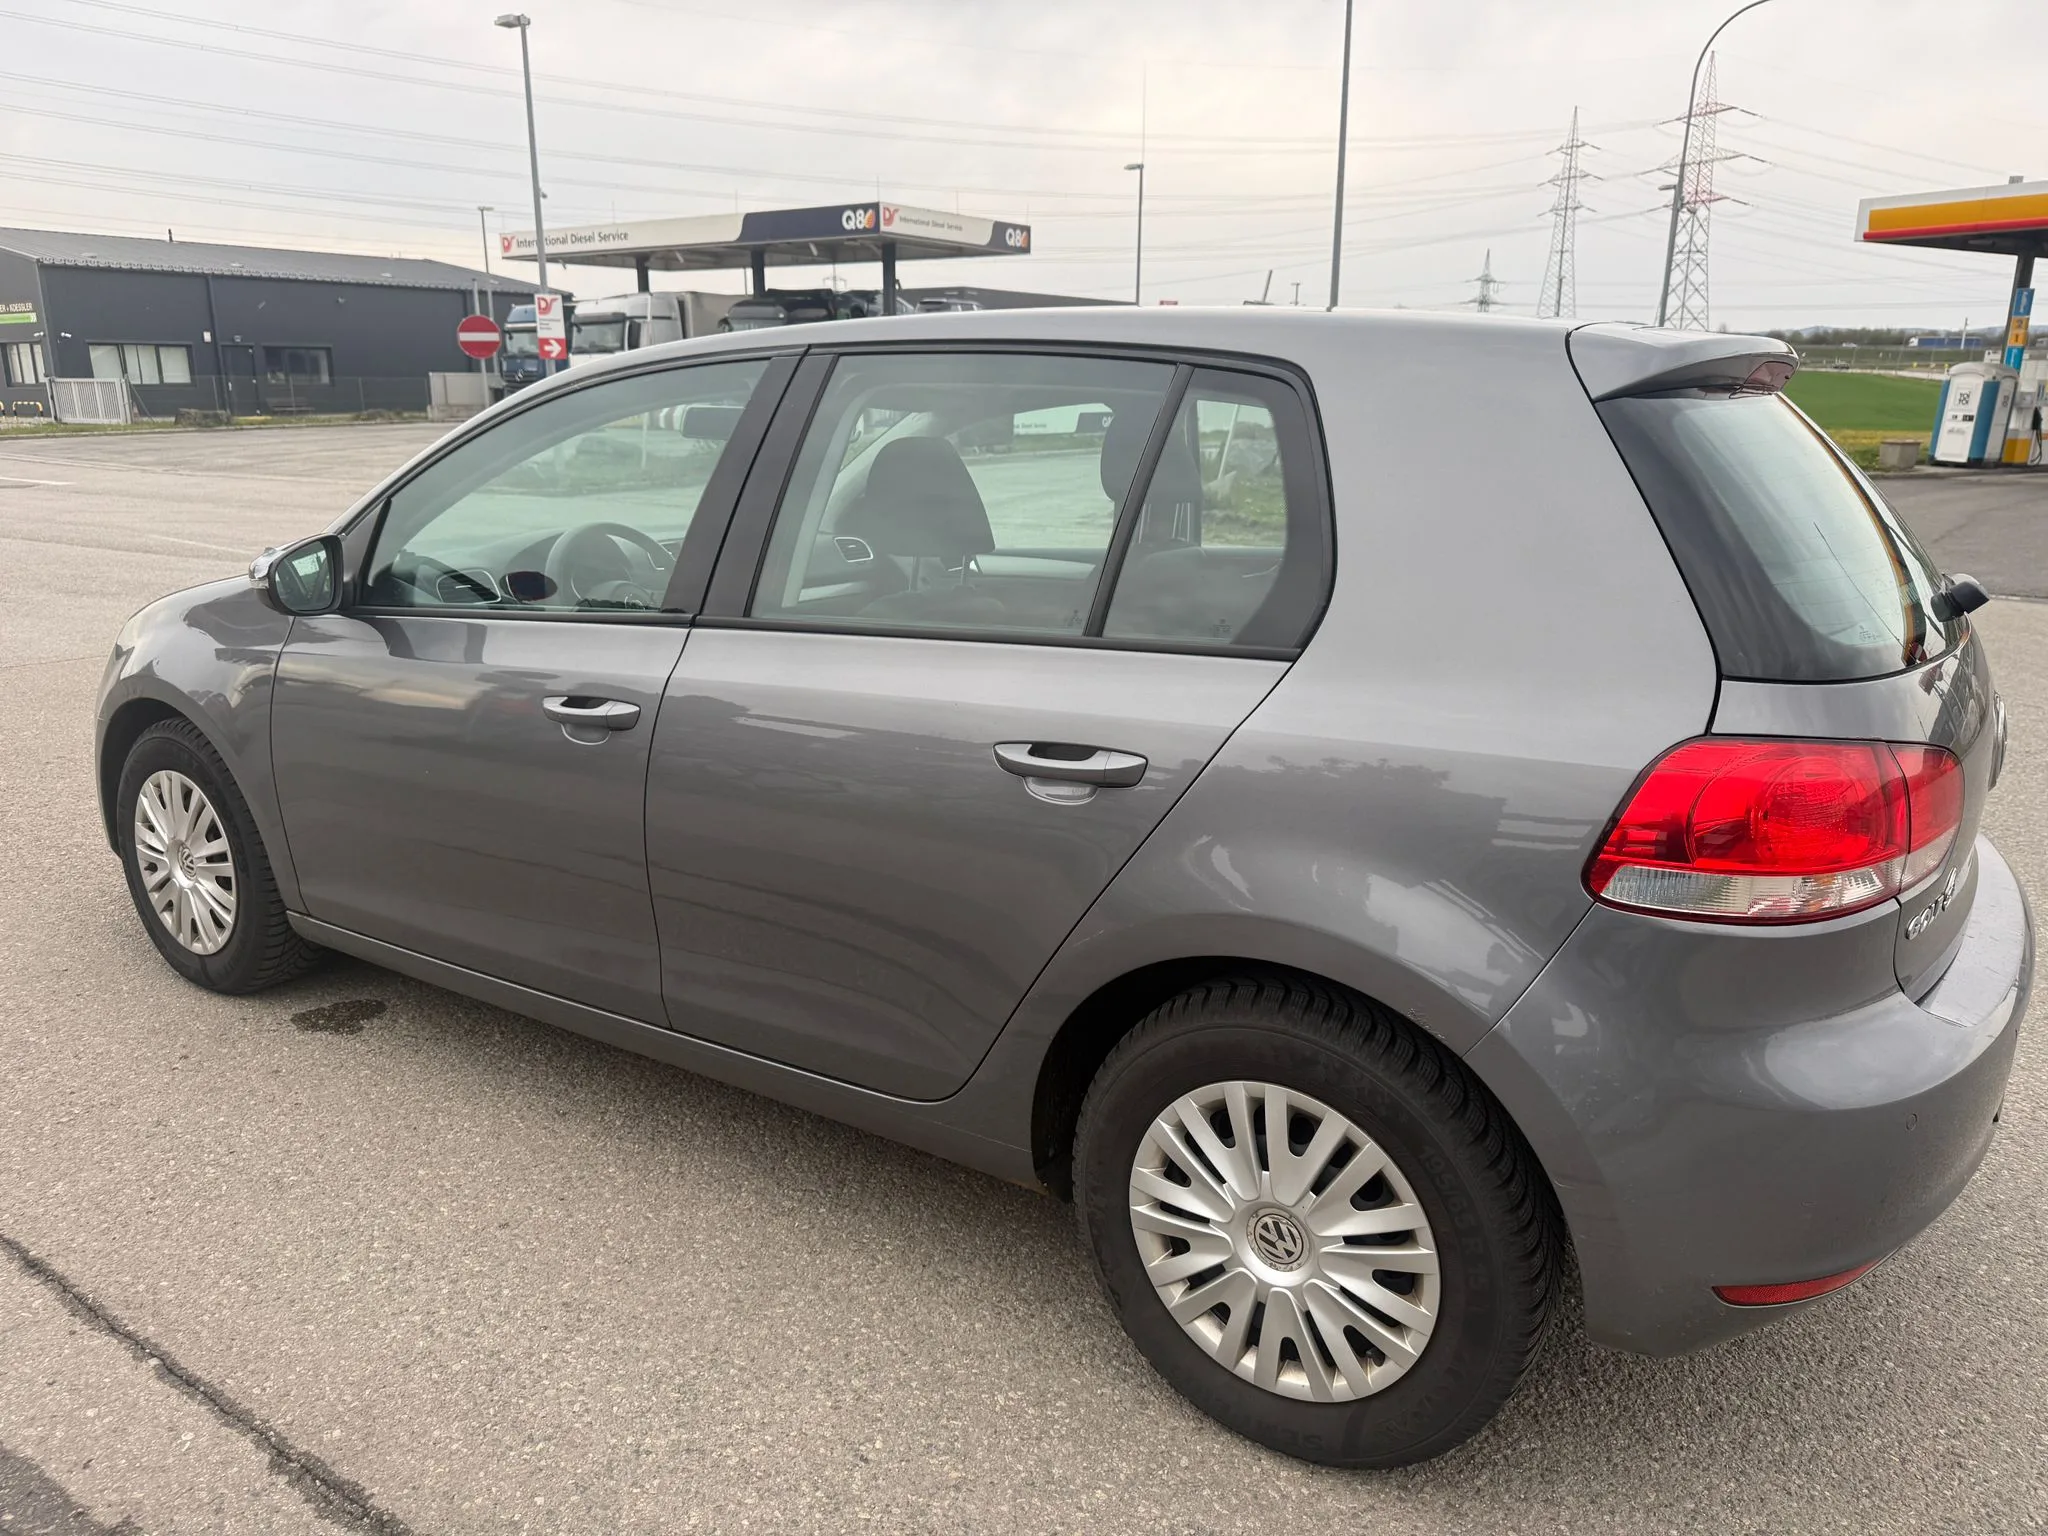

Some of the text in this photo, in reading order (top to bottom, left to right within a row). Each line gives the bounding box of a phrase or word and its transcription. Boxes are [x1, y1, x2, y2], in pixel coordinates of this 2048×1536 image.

[842, 208, 864, 230] Q8
[517, 229, 629, 248] Intertional Diesel Service
[1005, 228, 1021, 247] Q8
